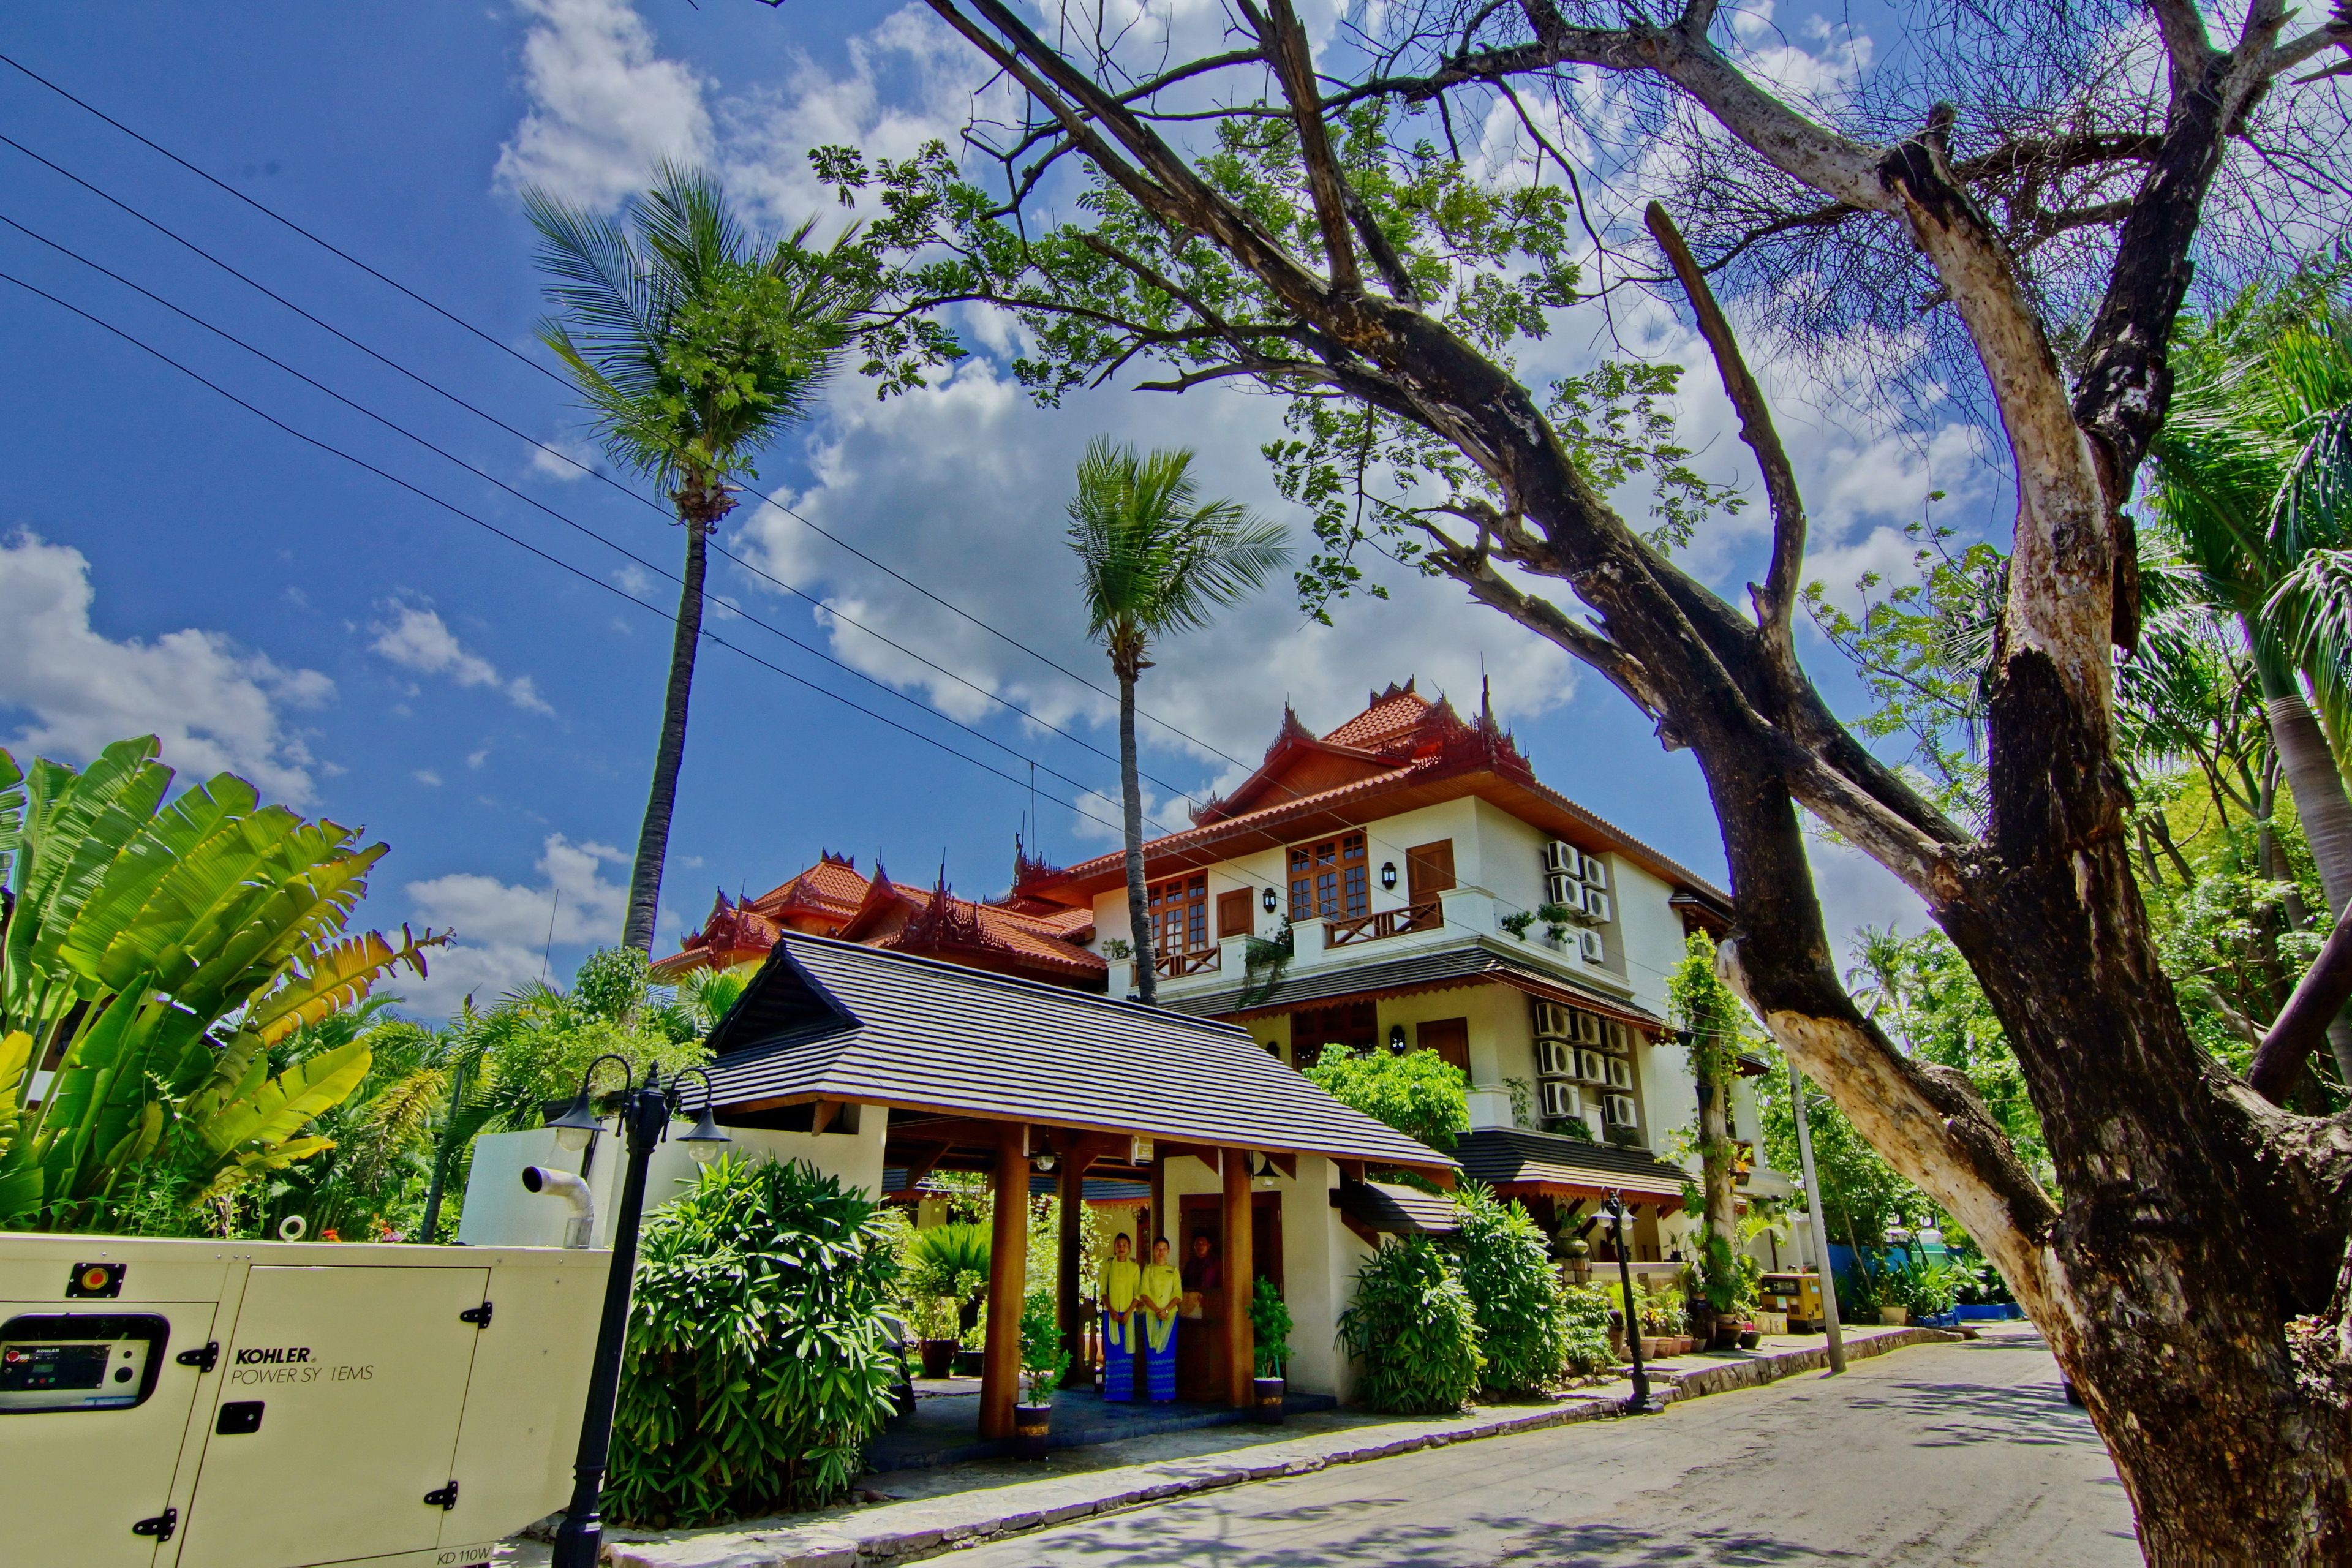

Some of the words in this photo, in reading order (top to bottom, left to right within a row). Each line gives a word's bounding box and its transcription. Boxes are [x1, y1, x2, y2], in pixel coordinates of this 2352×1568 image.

[236, 1348, 311, 1365] KOHLER
[231, 1368, 298, 1385] POWER
[301, 1365, 374, 1382] SYTEMS
[437, 1552, 456, 1565] KD
[460, 1547, 491, 1562] 110W
